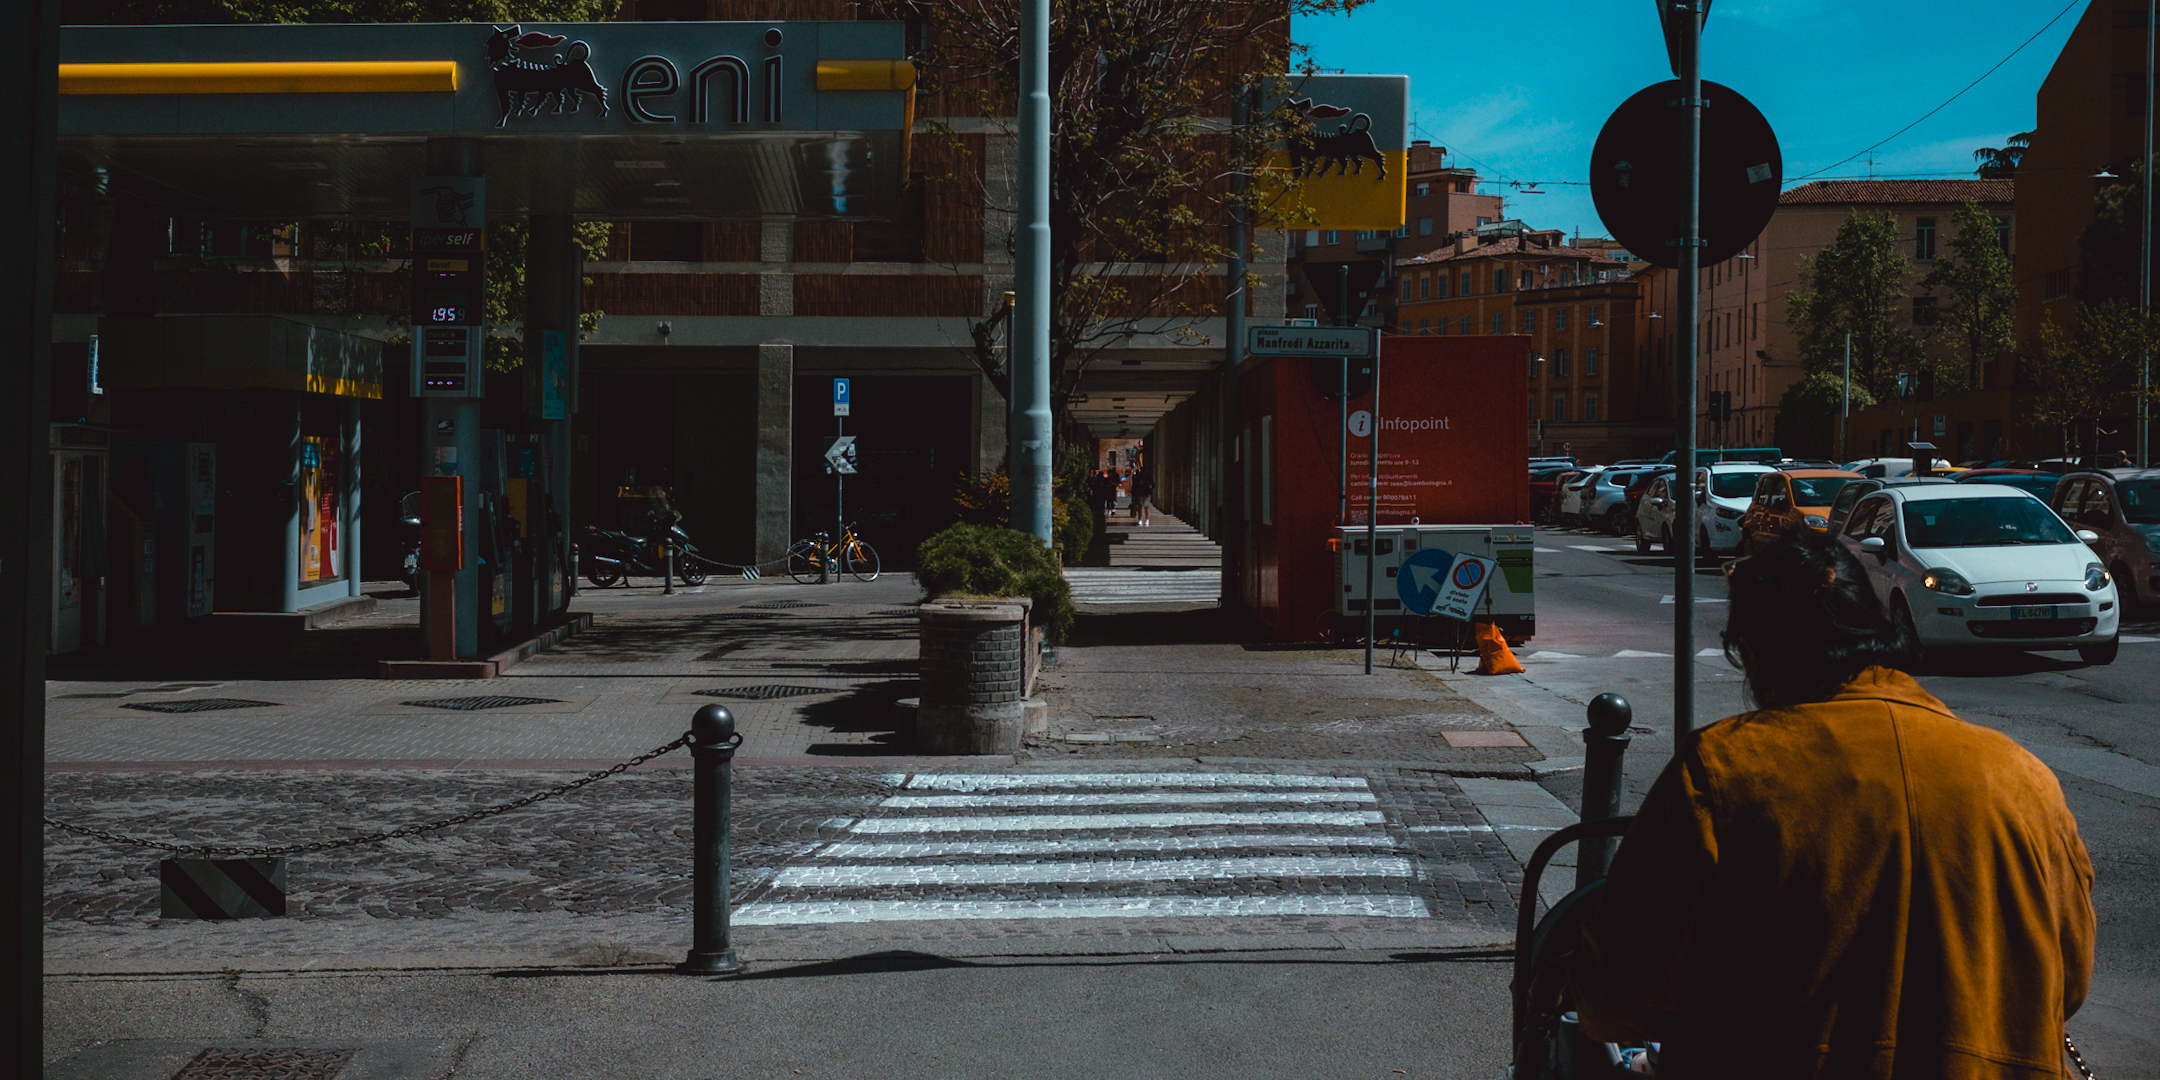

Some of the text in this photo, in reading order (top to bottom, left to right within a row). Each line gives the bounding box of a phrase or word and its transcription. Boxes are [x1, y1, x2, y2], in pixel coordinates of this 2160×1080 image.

[620, 27, 784, 124] eni
[419, 231, 474, 248] iperself
[429, 261, 451, 269] diesel
[1257, 337, 1350, 350] Manfredi Azzarita
[837, 382, 846, 400] P
[1380, 416, 1449, 433] Infopoint
